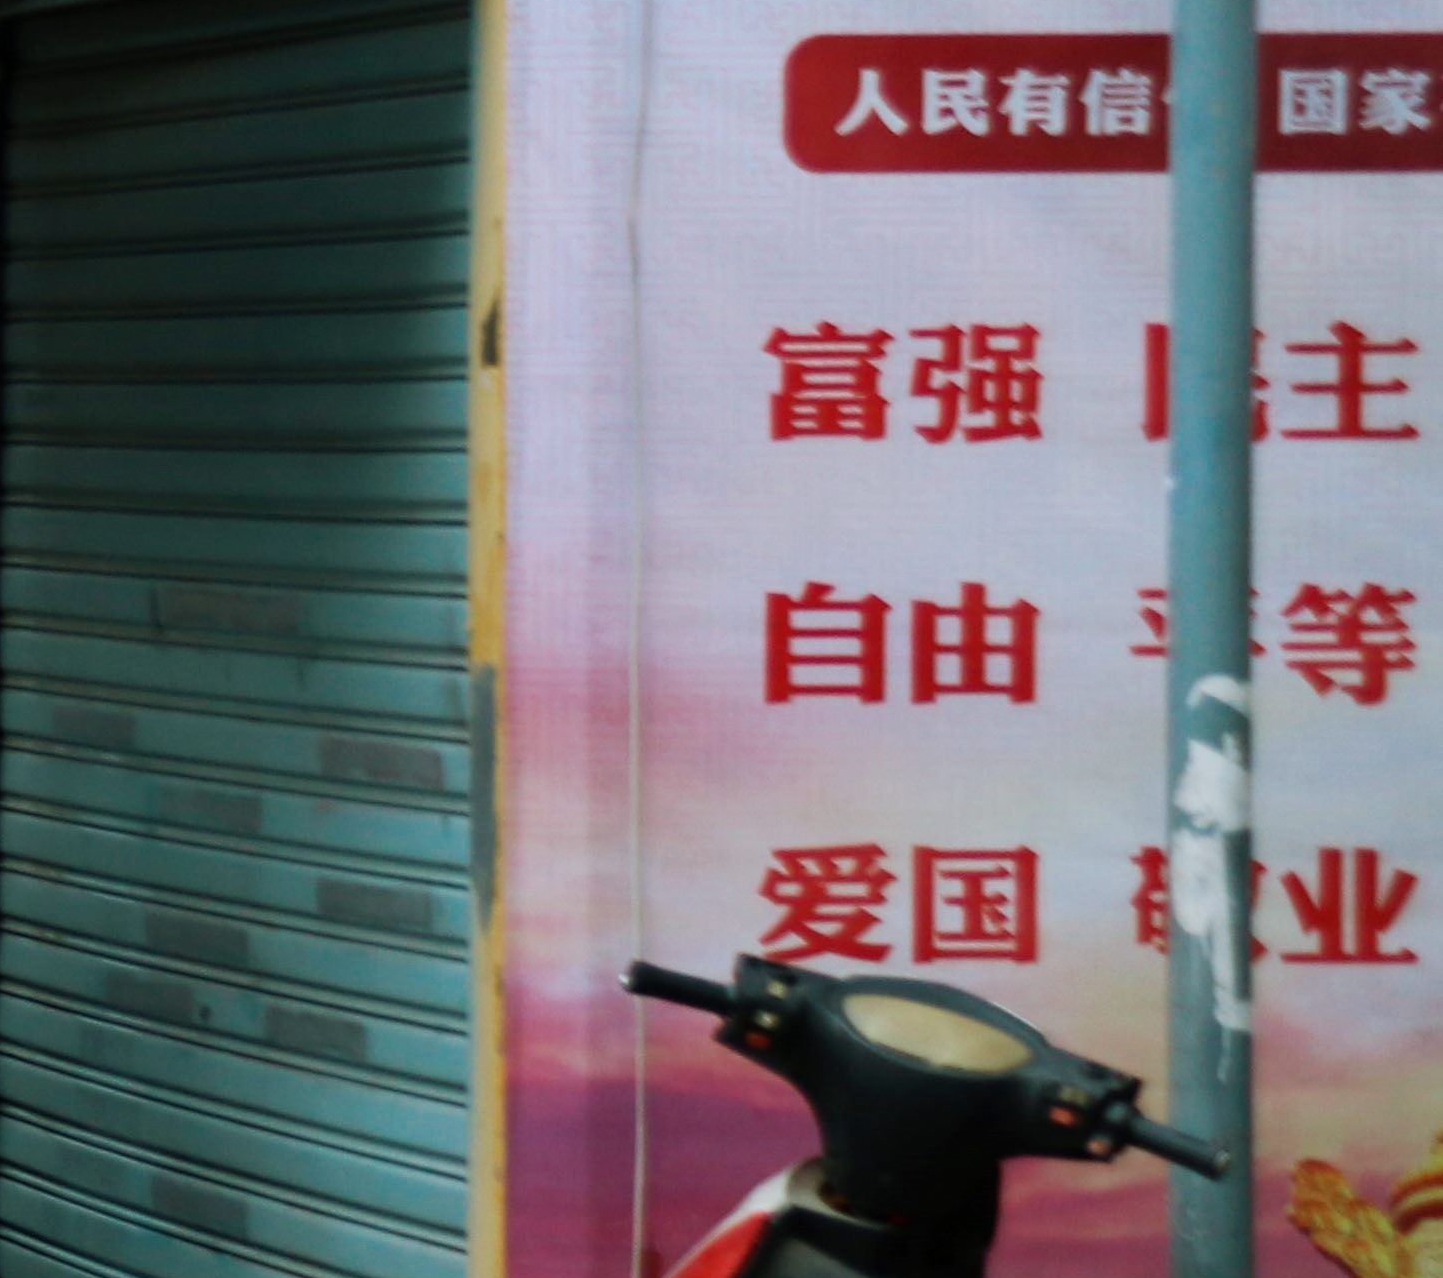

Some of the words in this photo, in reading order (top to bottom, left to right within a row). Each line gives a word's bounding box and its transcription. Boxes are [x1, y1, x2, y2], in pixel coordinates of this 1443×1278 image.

[834, 68, 1169, 137] 人民有信
[1277, 68, 1442, 137] 国家
[763, 322, 1043, 443] 富强
[764, 582, 1041, 706] 自由
[758, 843, 1039, 964] 爱国
